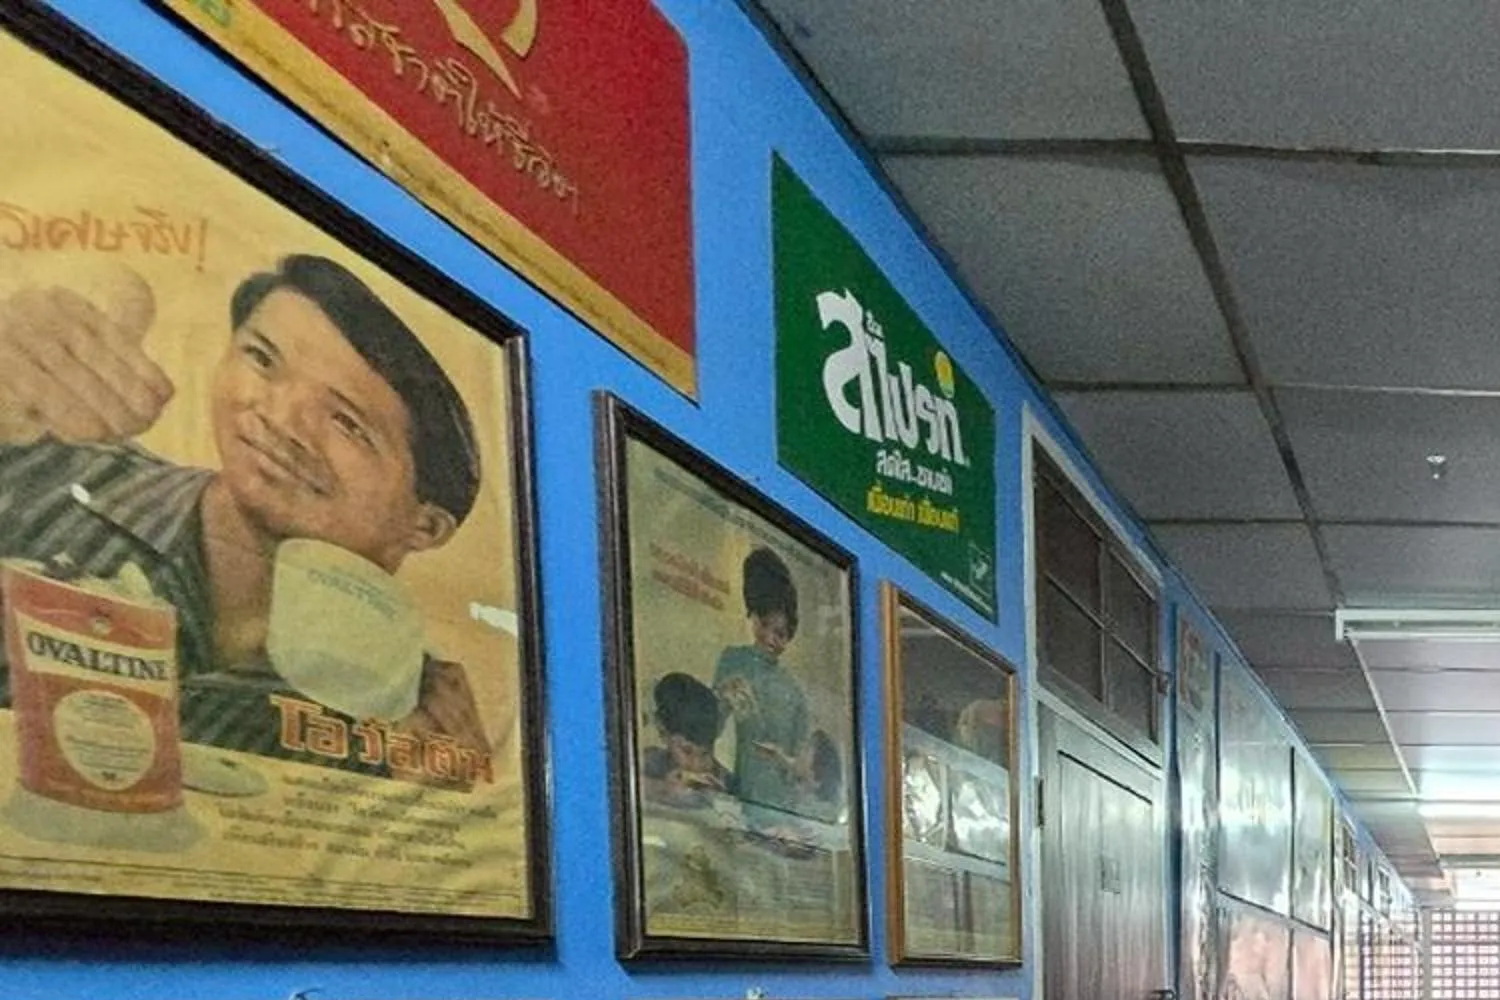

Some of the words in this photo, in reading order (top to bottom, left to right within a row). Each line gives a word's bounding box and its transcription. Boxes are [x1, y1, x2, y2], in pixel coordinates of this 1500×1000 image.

[27, 630, 170, 682] OVALTINE
[268, 689, 495, 785] โอวัลติน
